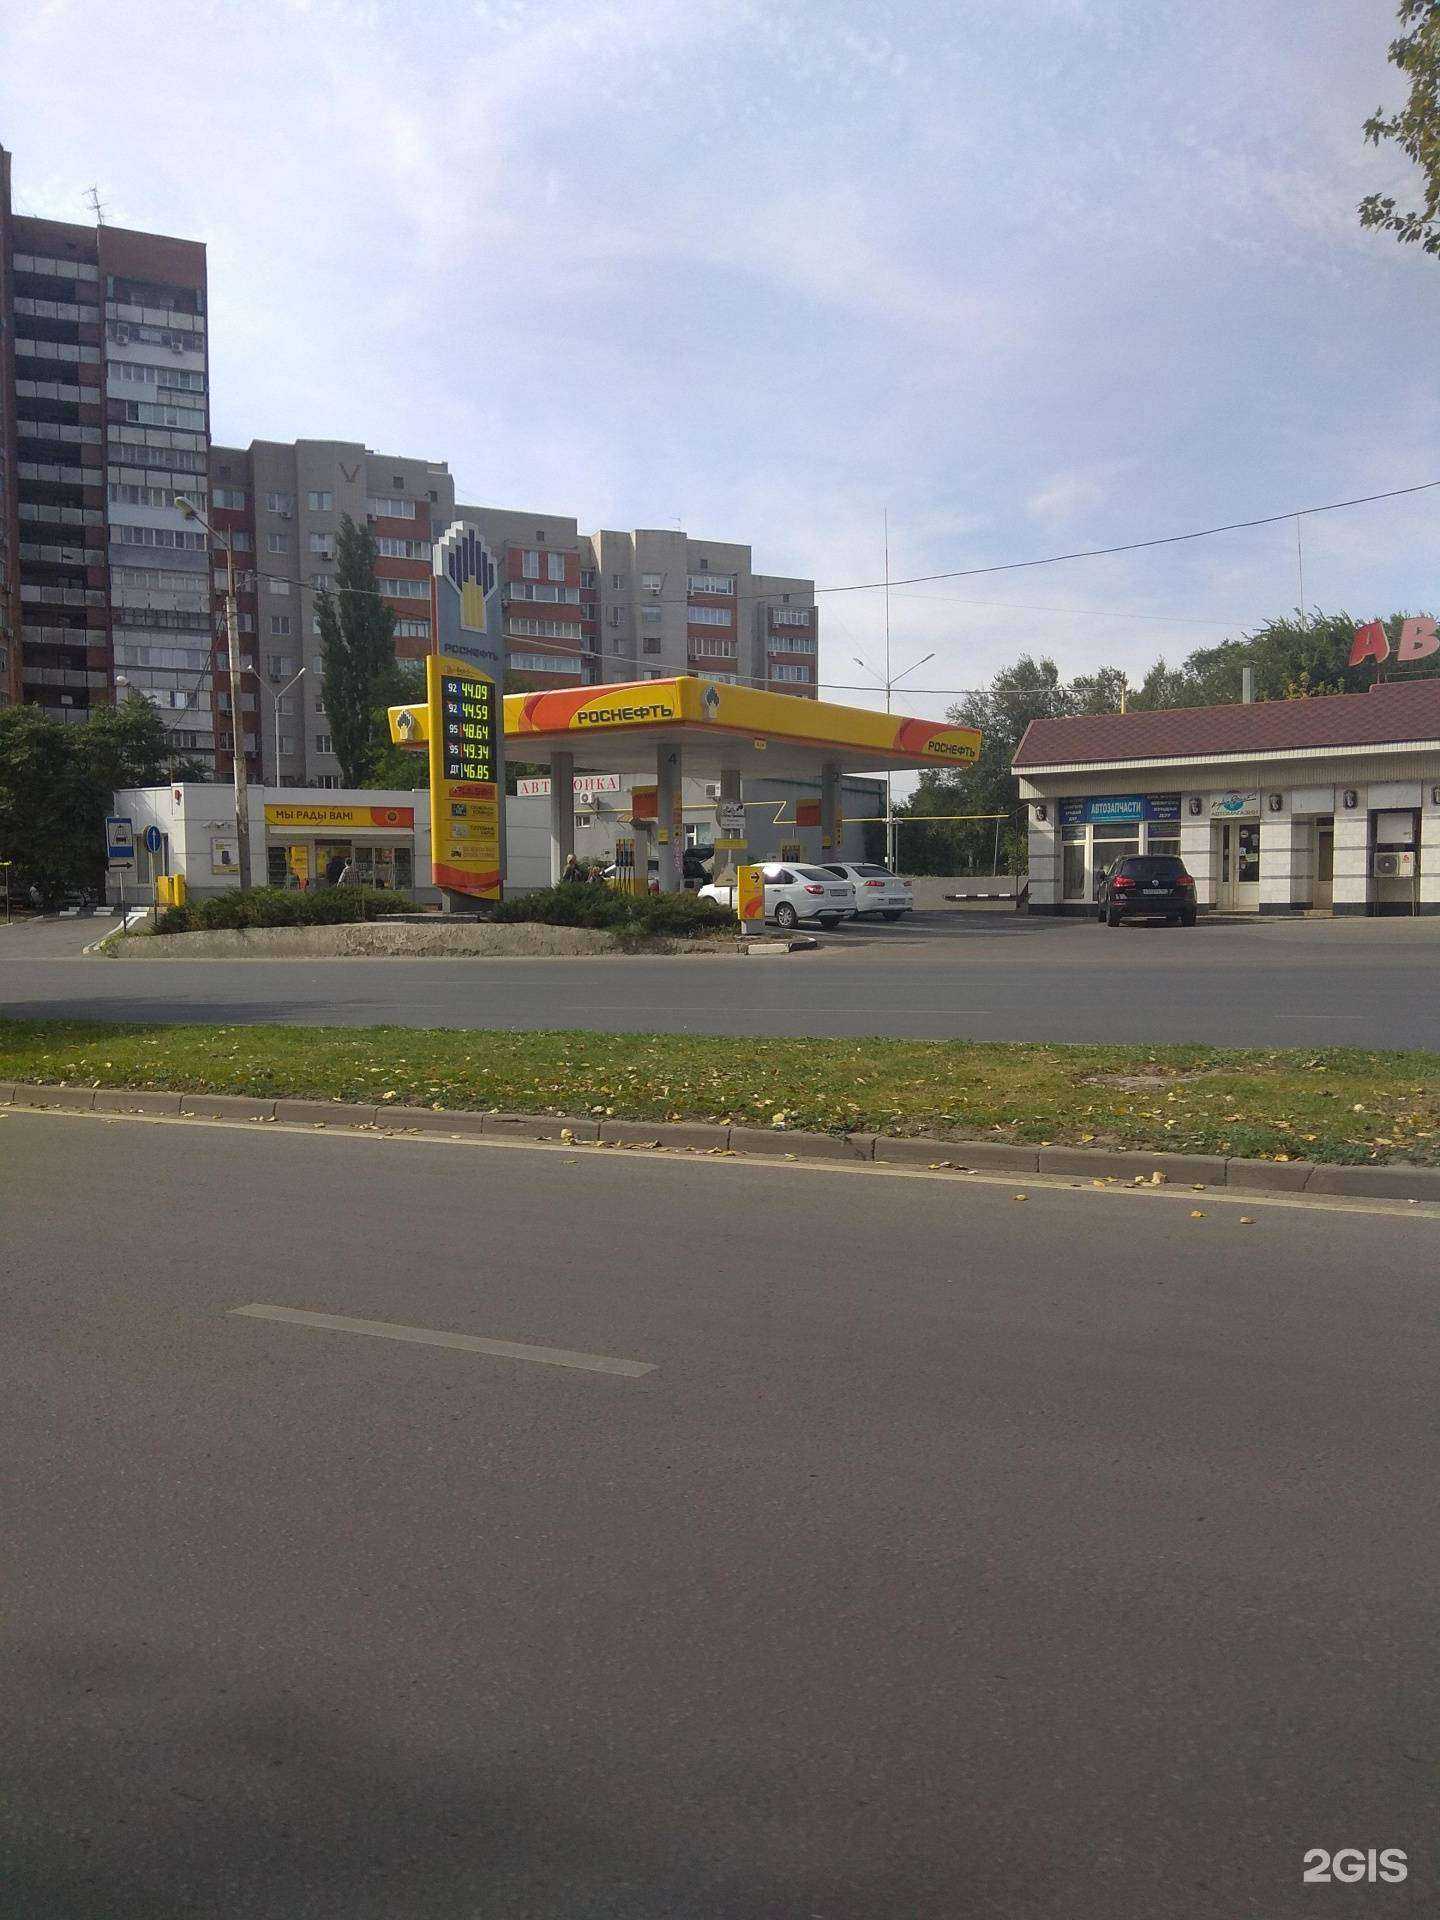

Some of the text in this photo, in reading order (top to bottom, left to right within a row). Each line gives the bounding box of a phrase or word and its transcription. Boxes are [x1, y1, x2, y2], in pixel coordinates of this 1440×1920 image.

[448, 682, 488, 700] 92 44.09
[448, 703, 488, 720] 92 44.59
[577, 704, 672, 724] РОСНЕФТЬ
[449, 723, 489, 740] 95 48.64
[449, 743, 489, 760] 95 49.34
[928, 740, 976, 758] РОСНЕФТЬ
[668, 752, 678, 766] 4
[450, 763, 489, 780] ДТ 46.85
[276, 810, 294, 820] МЫ
[297, 810, 327, 821] РАДЫ
[1090, 801, 1141, 815] АВТОЗАПЧАСТИ
